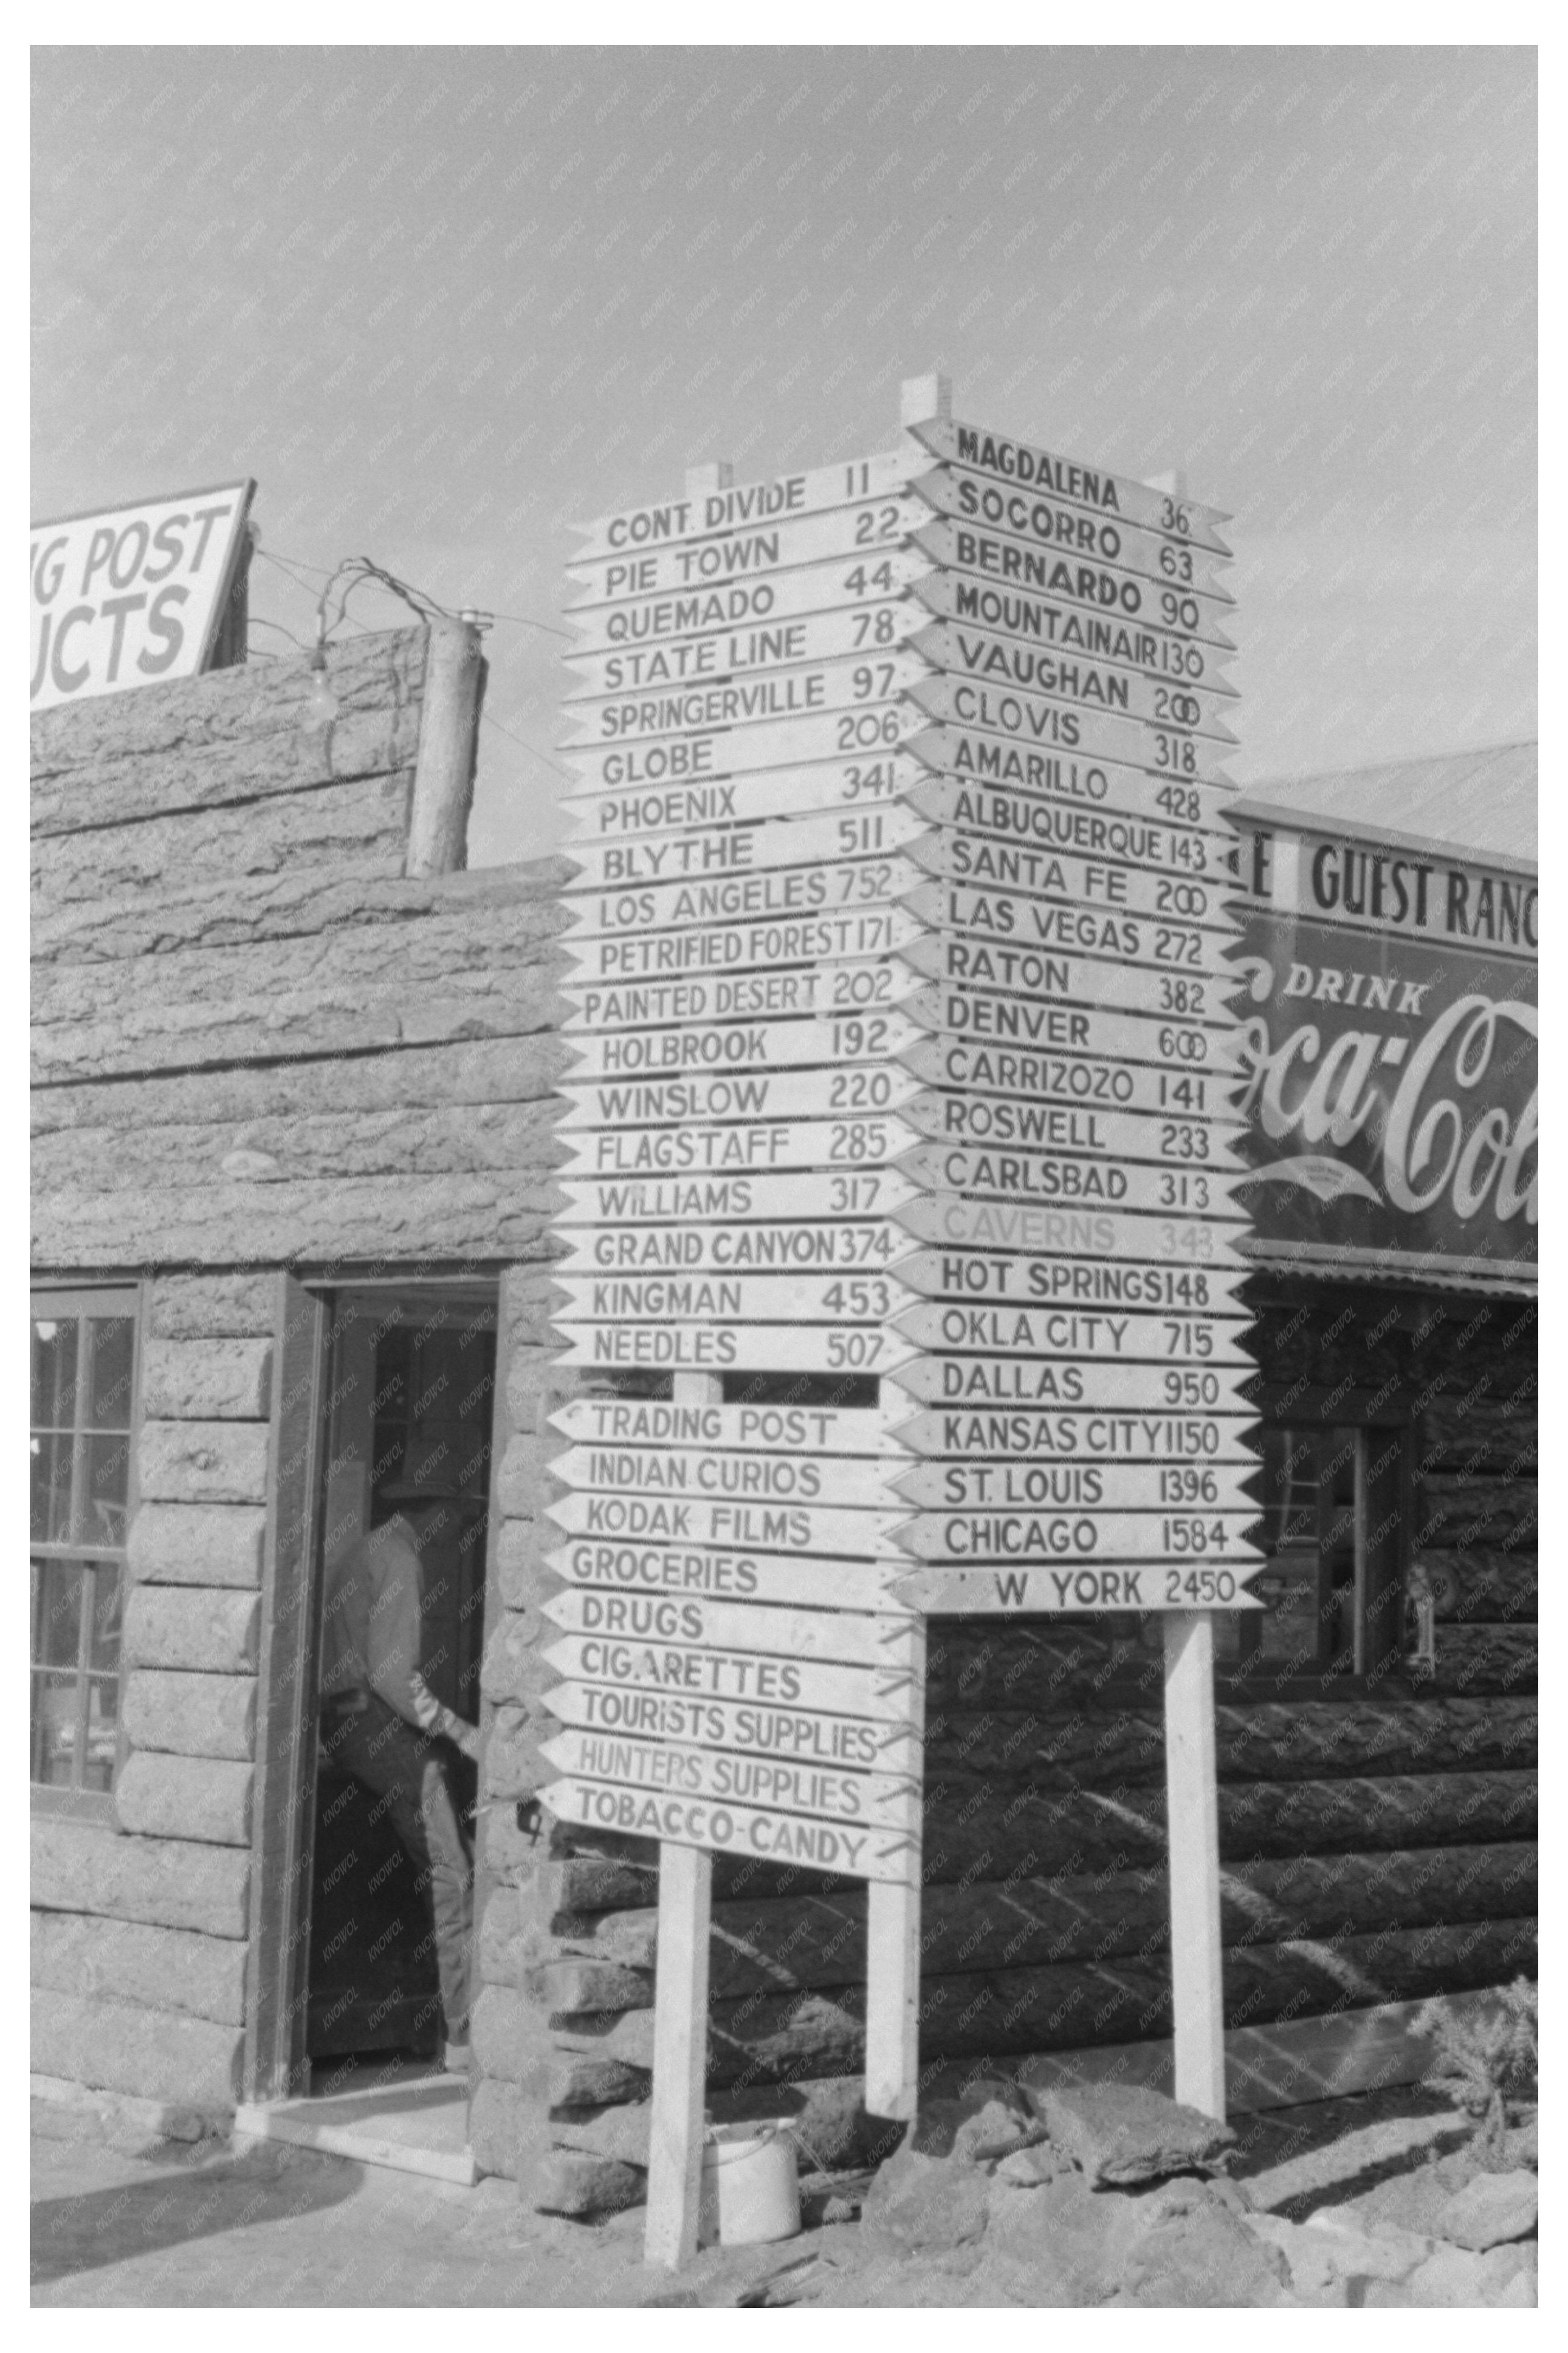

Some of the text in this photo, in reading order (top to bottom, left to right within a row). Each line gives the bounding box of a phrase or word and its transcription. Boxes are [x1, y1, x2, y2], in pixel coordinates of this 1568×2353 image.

[706, 477, 806, 528] DIVIDE
[847, 463, 868, 497] 11
[958, 427, 1189, 535] MAGDALENA 36
[30, 505, 232, 605] G POST
[607, 506, 900, 596] PIE TOWN 22
[958, 480, 1193, 582] SOCORRO 63
[607, 561, 892, 641] QUEMADO 44
[957, 531, 1199, 630] BERNARDO 90
[605, 608, 895, 689] STATE LINE 78
[955, 582, 1205, 679] MOUNTAINAIR 130
[601, 663, 895, 737] SPRINGERVILLE 97
[956, 633, 1201, 727] VAUGHAN 200
[602, 710, 899, 784] GLOBE 206
[955, 686, 1196, 773] CLOVIS 318
[600, 762, 895, 832] PHOENIX 341
[954, 738, 1200, 822] AMARILLO 428
[603, 816, 882, 880] BLYTHE 511
[953, 790, 1207, 871] ALBUQUERQUE 143
[601, 864, 892, 928] LOS ANGELES 752
[952, 839, 1208, 917] SANTA FE 200
[1312, 844, 1434, 928] GUEST
[600, 915, 892, 975] PETRIFIED FOREST 171
[950, 891, 1202, 966] LAS VEGAS 272
[585, 969, 893, 1024] PAINTED DESERT 202
[947, 943, 1205, 1015] RATON 382
[1283, 963, 1432, 1014] DRINK
[603, 1019, 889, 1070] HOLBROOK 192
[947, 995, 1207, 1062] DENVER 600
[597, 1073, 891, 1120] WINSLOW 220
[946, 1047, 1205, 1111] CARRIZOZO 141
[597, 1123, 887, 1170] FLAGSTAFF 285
[945, 1098, 1210, 1160] ROSWELL 233
[598, 1177, 881, 1216] WILLIAMS 317
[945, 1152, 1209, 1209] CARLSBAD 313
[594, 1227, 891, 1266] GRAND CANYON 374
[944, 1204, 1116, 1252] CAVERNS
[593, 1280, 890, 1316] KINGMAN 453
[942, 1256, 1209, 1307] HOT SPRINGS 148
[594, 1329, 885, 1368] NEEDLES 507
[942, 1309, 1214, 1357] OKLA CITY 715
[943, 1362, 1220, 1405] DALLAS 950
[591, 1405, 837, 1445] TRADING POST
[944, 1416, 1220, 1455] KANSAS CITY 1150
[590, 1453, 820, 1497] INDIAN CURIOS
[944, 1467, 1218, 1504] ST. LOUIS 1396
[586, 1498, 811, 1546] KODAK FILMS
[944, 1519, 1229, 1554] CHICAGO 1584
[573, 1546, 758, 1593] GROCERIES
[1051, 1570, 1142, 1607] YORK
[1166, 1569, 1237, 1604] 2450
[581, 1596, 704, 1639] DRUGS
[580, 1641, 801, 1701] CIGARETTES
[582, 1688, 877, 1764] TOURISTS SUPPLIES
[580, 1738, 861, 1816] HUNTERS SUPPLIES
